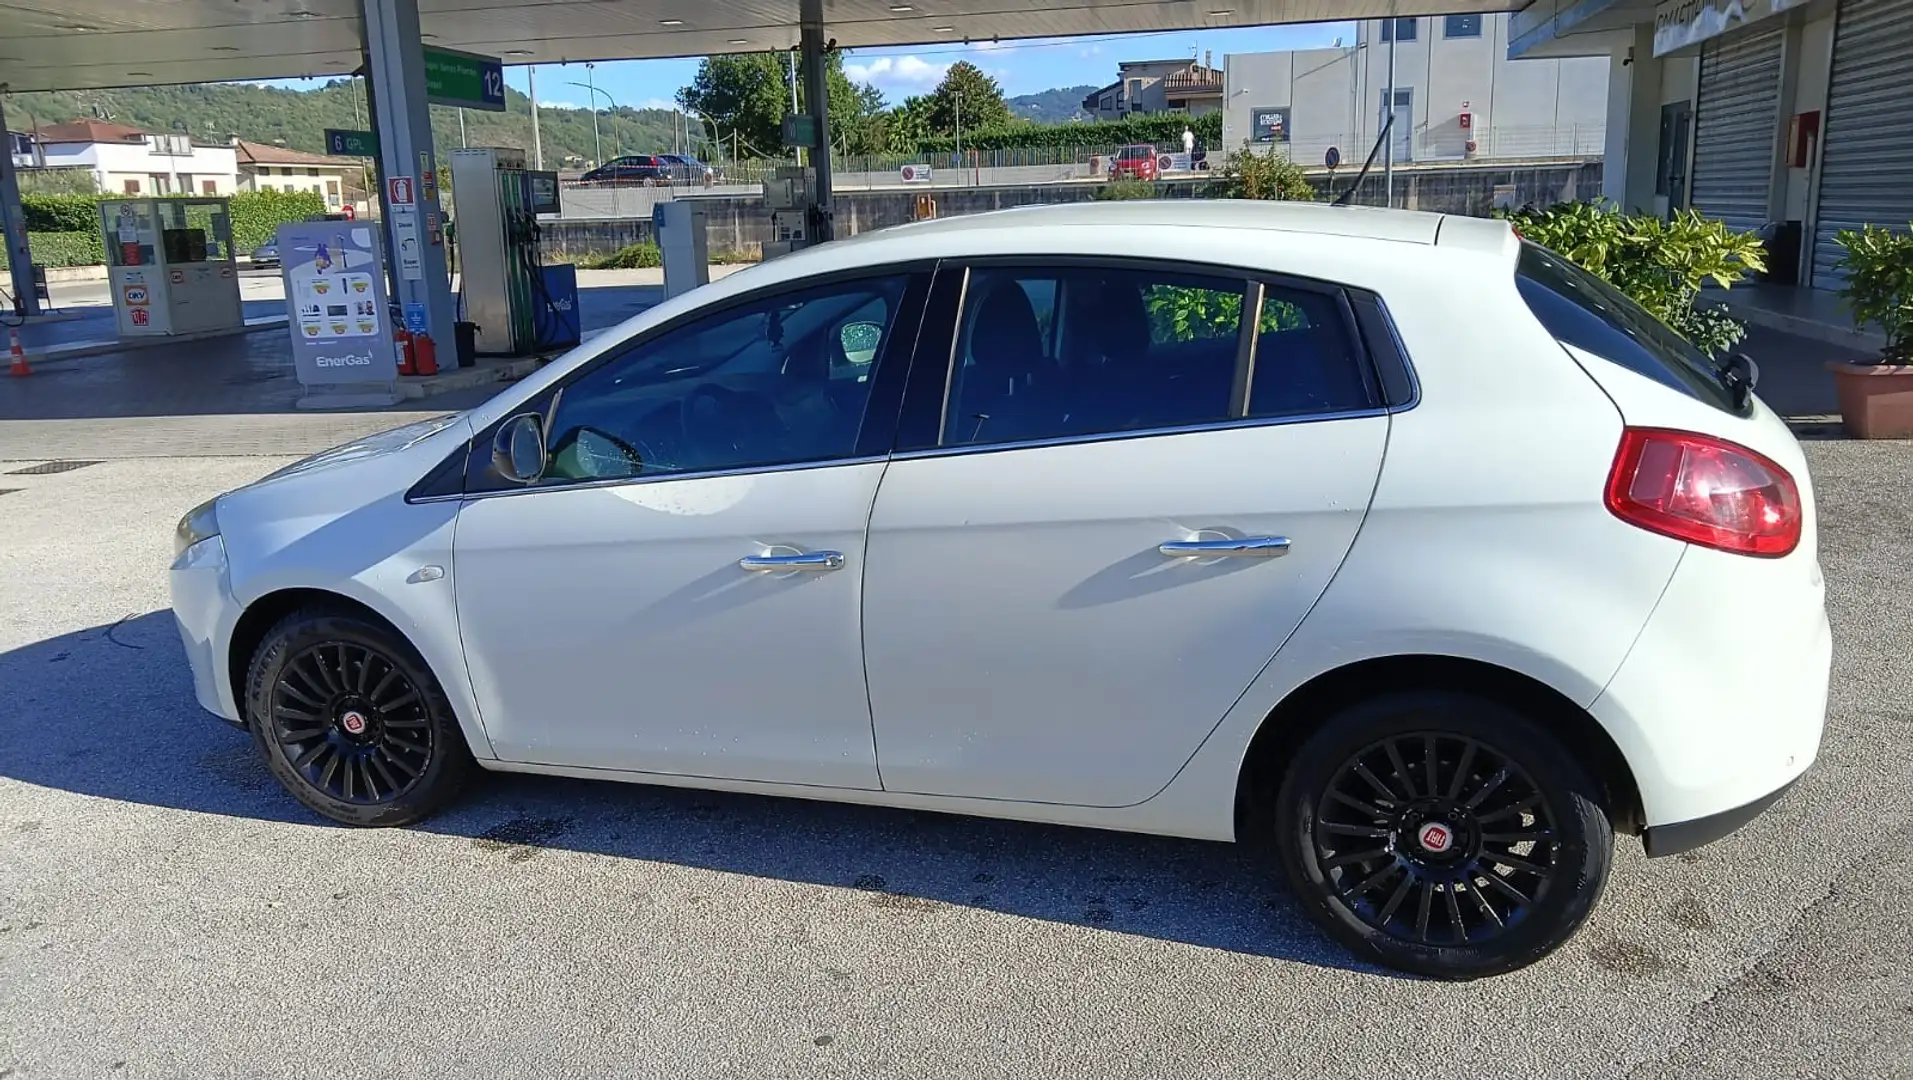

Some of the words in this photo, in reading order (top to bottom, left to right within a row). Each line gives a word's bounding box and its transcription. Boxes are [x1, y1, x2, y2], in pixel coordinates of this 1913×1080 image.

[484, 69, 502, 97] 12
[334, 135, 342, 151] 6
[346, 137, 365, 150] GPL
[315, 354, 371, 368] EnerGas
[1425, 829, 1446, 847] FIAT
